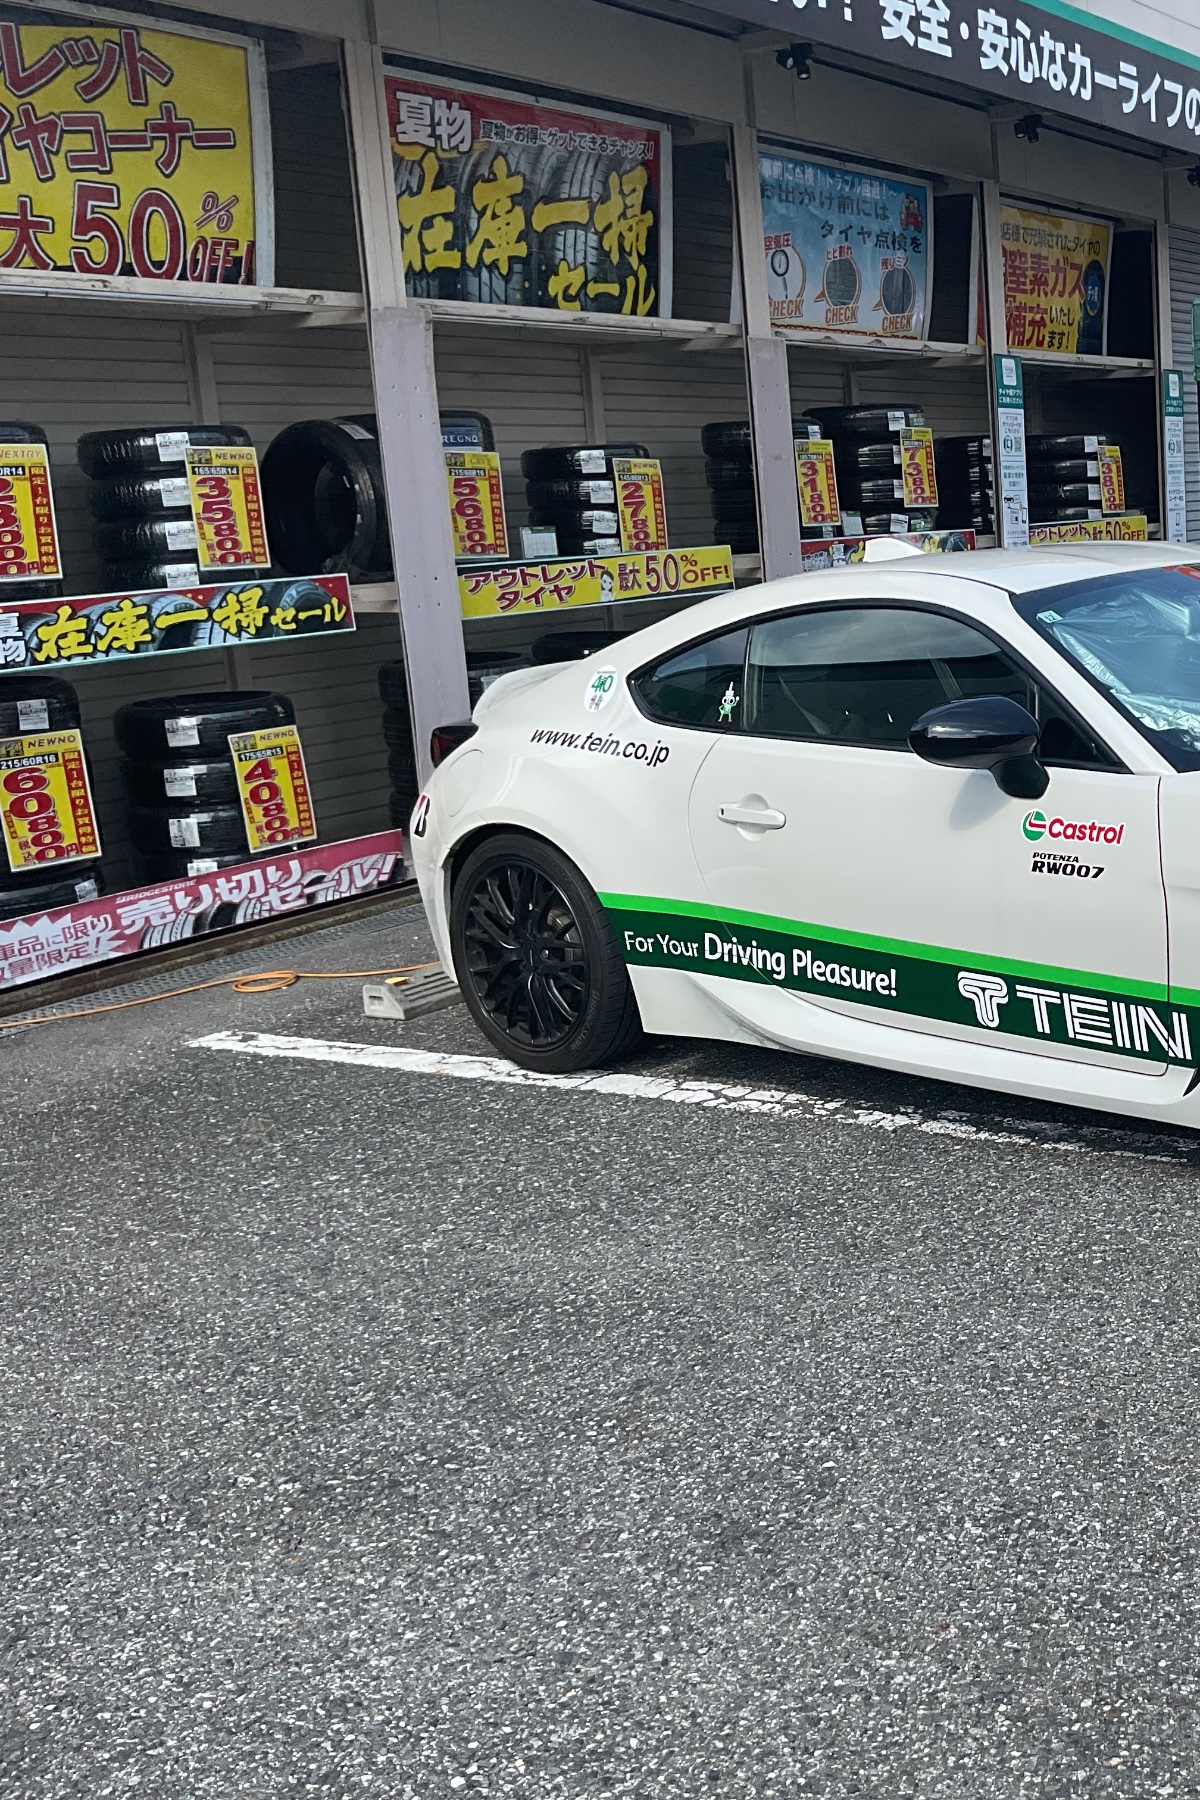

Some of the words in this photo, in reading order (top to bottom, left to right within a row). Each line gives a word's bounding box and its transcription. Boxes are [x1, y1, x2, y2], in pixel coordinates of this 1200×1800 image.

[395, 91, 472, 151] 夏物
[397, 152, 654, 275] 在庫一掃
[764, 232, 792, 251] 空気圧
[820, 219, 923, 254] タイヤ点検を
[548, 260, 656, 317] セール
[825, 307, 858, 327] CHECK
[881, 315, 912, 335] CHECK
[442, 435, 478, 443] REGNO
[215, 452, 253, 461] NEWNO
[464, 558, 607, 596] アウトレット
[496, 582, 576, 612] タイヤ
[28, 734, 76, 748] NEWNO
[260, 730, 295, 742] NEWNO
[530, 729, 670, 767] www.tein.co.jp
[1, 754, 56, 769] 215/60R16
[1048, 818, 1124, 844] Castrol
[1033, 852, 1079, 863] POTENZA
[1031, 860, 1105, 879] RW007
[624, 931, 654, 953] For
[656, 933, 699, 957] Your
[704, 931, 786, 980] Driving
[792, 949, 898, 997] Pleasure!
[1015, 984, 1193, 1061] TEIN
